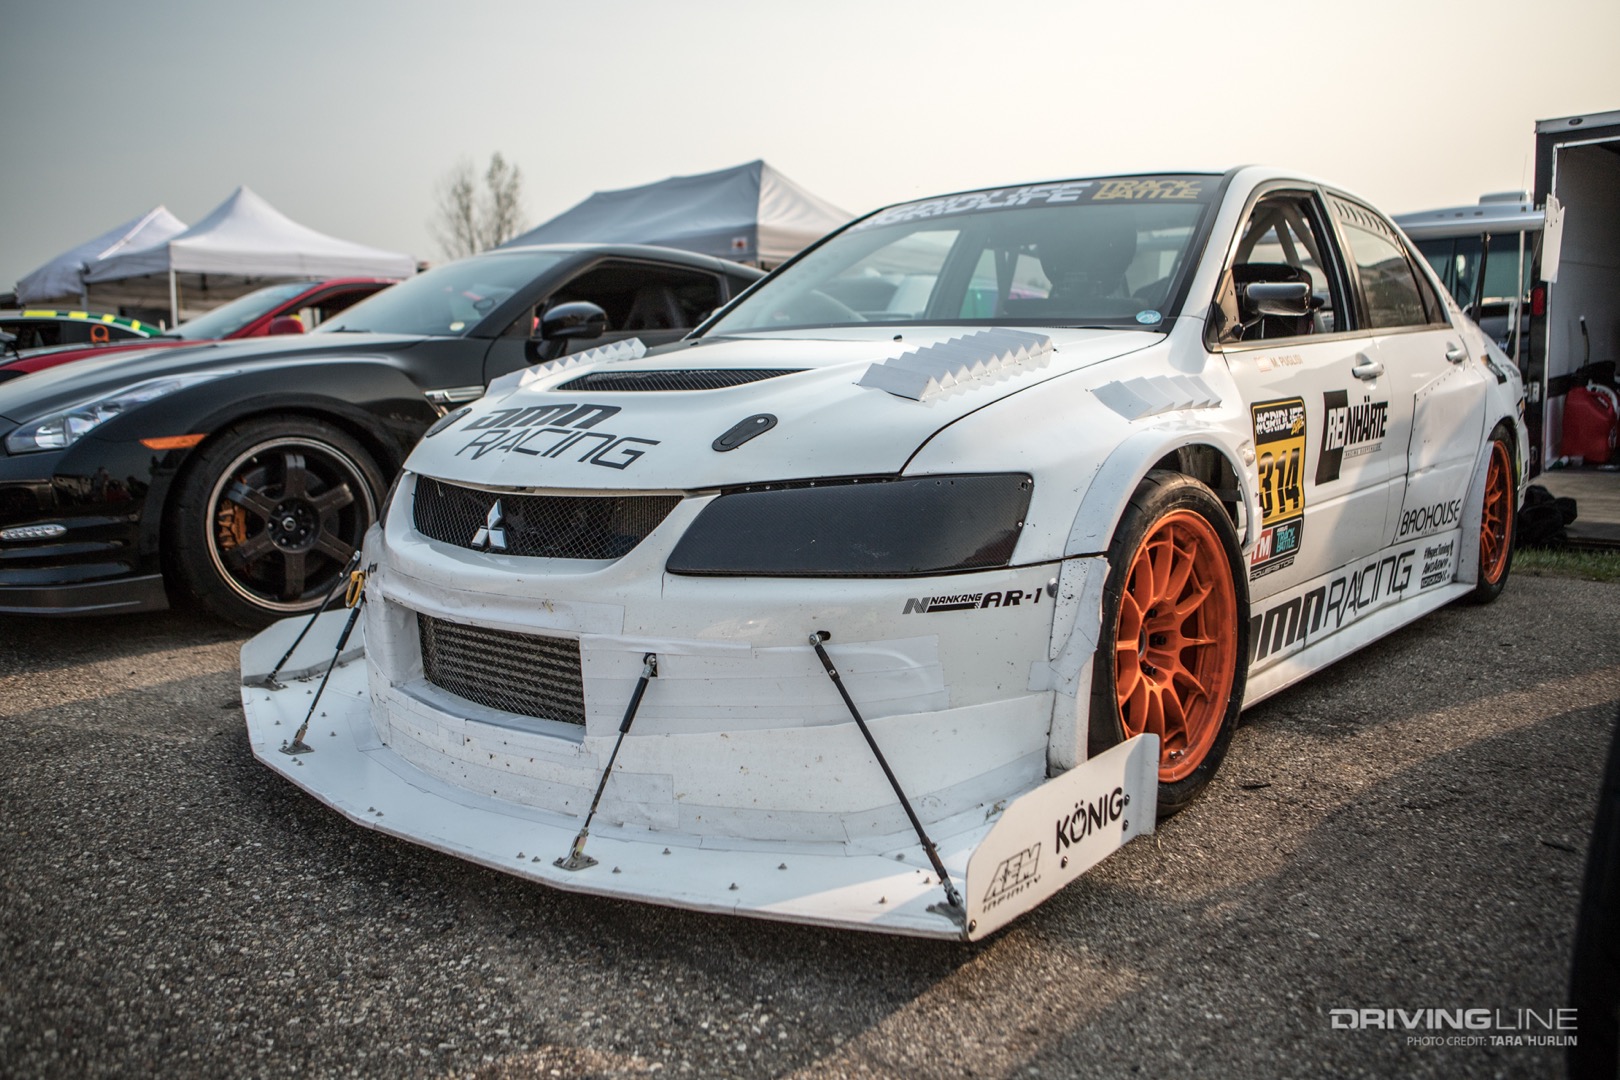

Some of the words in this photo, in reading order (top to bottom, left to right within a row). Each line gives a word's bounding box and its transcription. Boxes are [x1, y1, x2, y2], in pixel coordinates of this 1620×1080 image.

[1091, 189, 1201, 200] BATTLE
[1098, 180, 1203, 190] TRACK
[1325, 395, 1388, 452] REINHÄRTE
[454, 428, 662, 471] RACING
[1258, 447, 1300, 519] 314
[929, 593, 983, 605] NANKANG
[980, 587, 1043, 609] AR-1
[1324, 549, 1416, 629] RACING
[1055, 787, 1124, 854] KÖNIG
